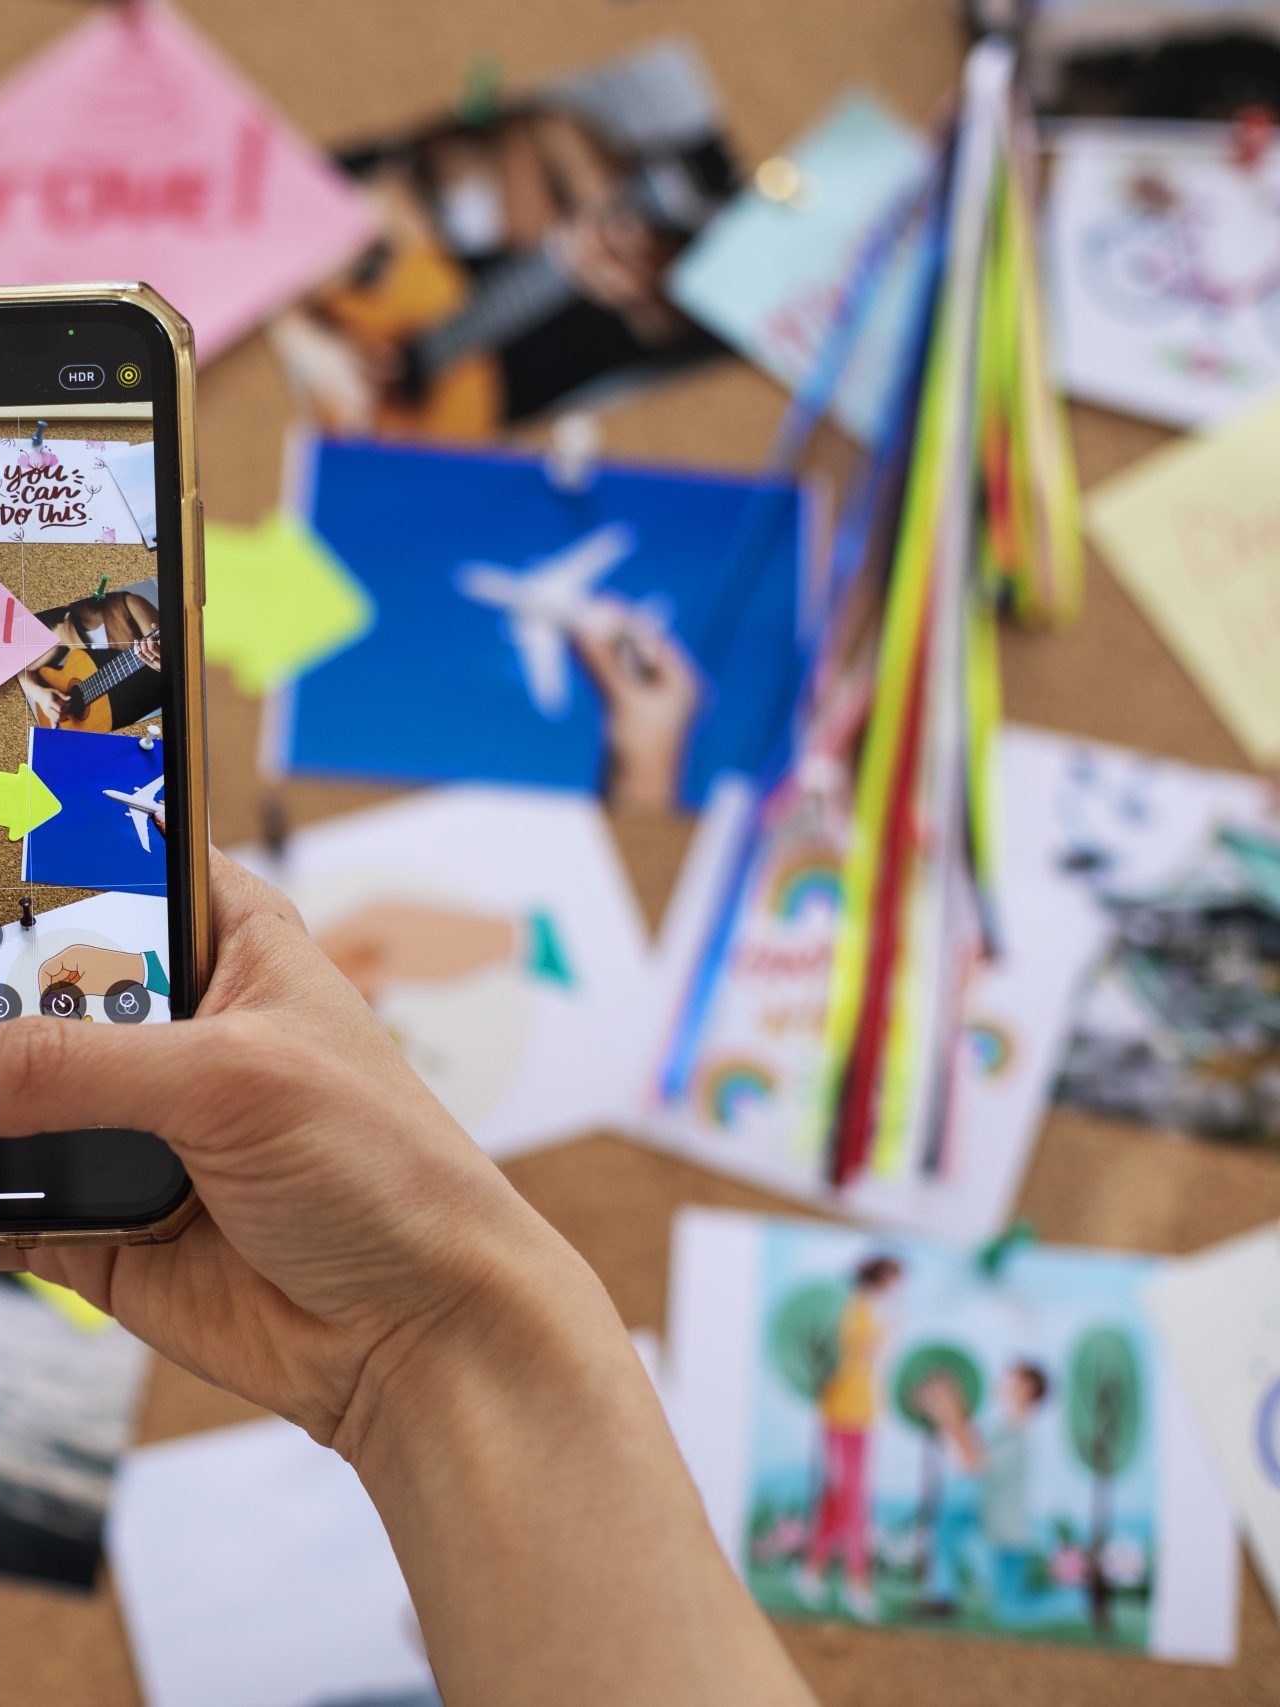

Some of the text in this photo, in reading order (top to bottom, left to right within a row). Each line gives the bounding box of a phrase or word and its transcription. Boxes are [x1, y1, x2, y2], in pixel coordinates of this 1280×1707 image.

[68, 371, 95, 382] HDR
[3, 464, 68, 492] you
[21, 485, 81, 504] can
